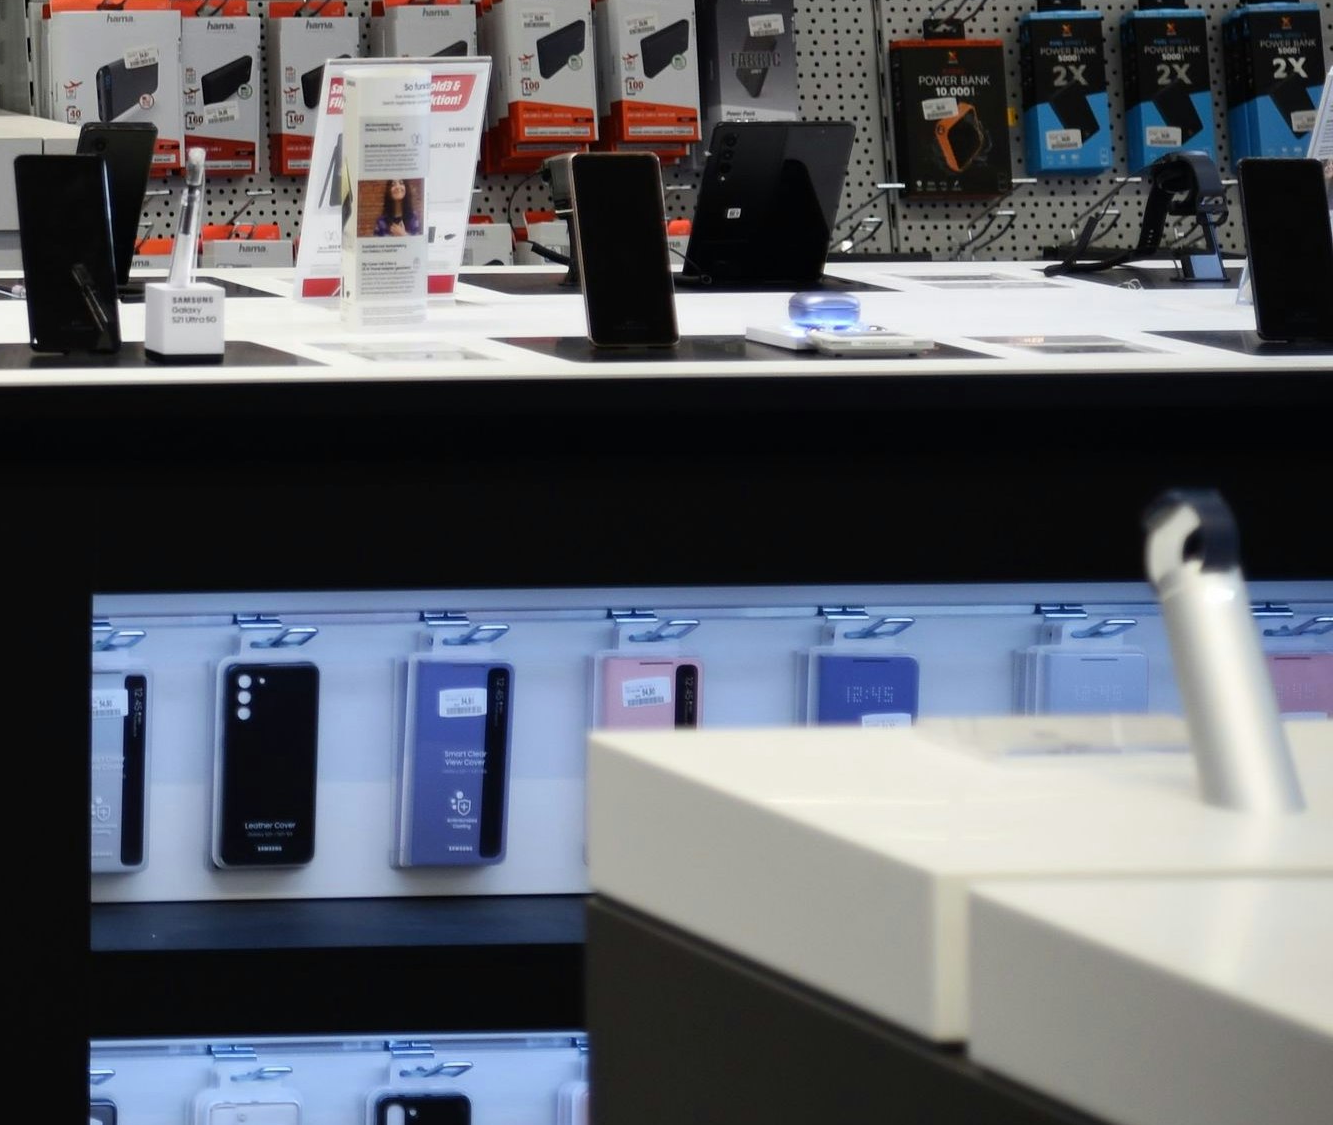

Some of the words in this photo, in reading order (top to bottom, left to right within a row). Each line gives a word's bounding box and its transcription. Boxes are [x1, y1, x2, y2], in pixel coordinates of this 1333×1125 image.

[1053, 64, 1088, 86] 2X
[1157, 64, 1192, 85] 2X
[1272, 57, 1308, 78] 2X
[172, 296, 214, 304] SAMSUNG
[172, 307, 202, 315] Galaxy
